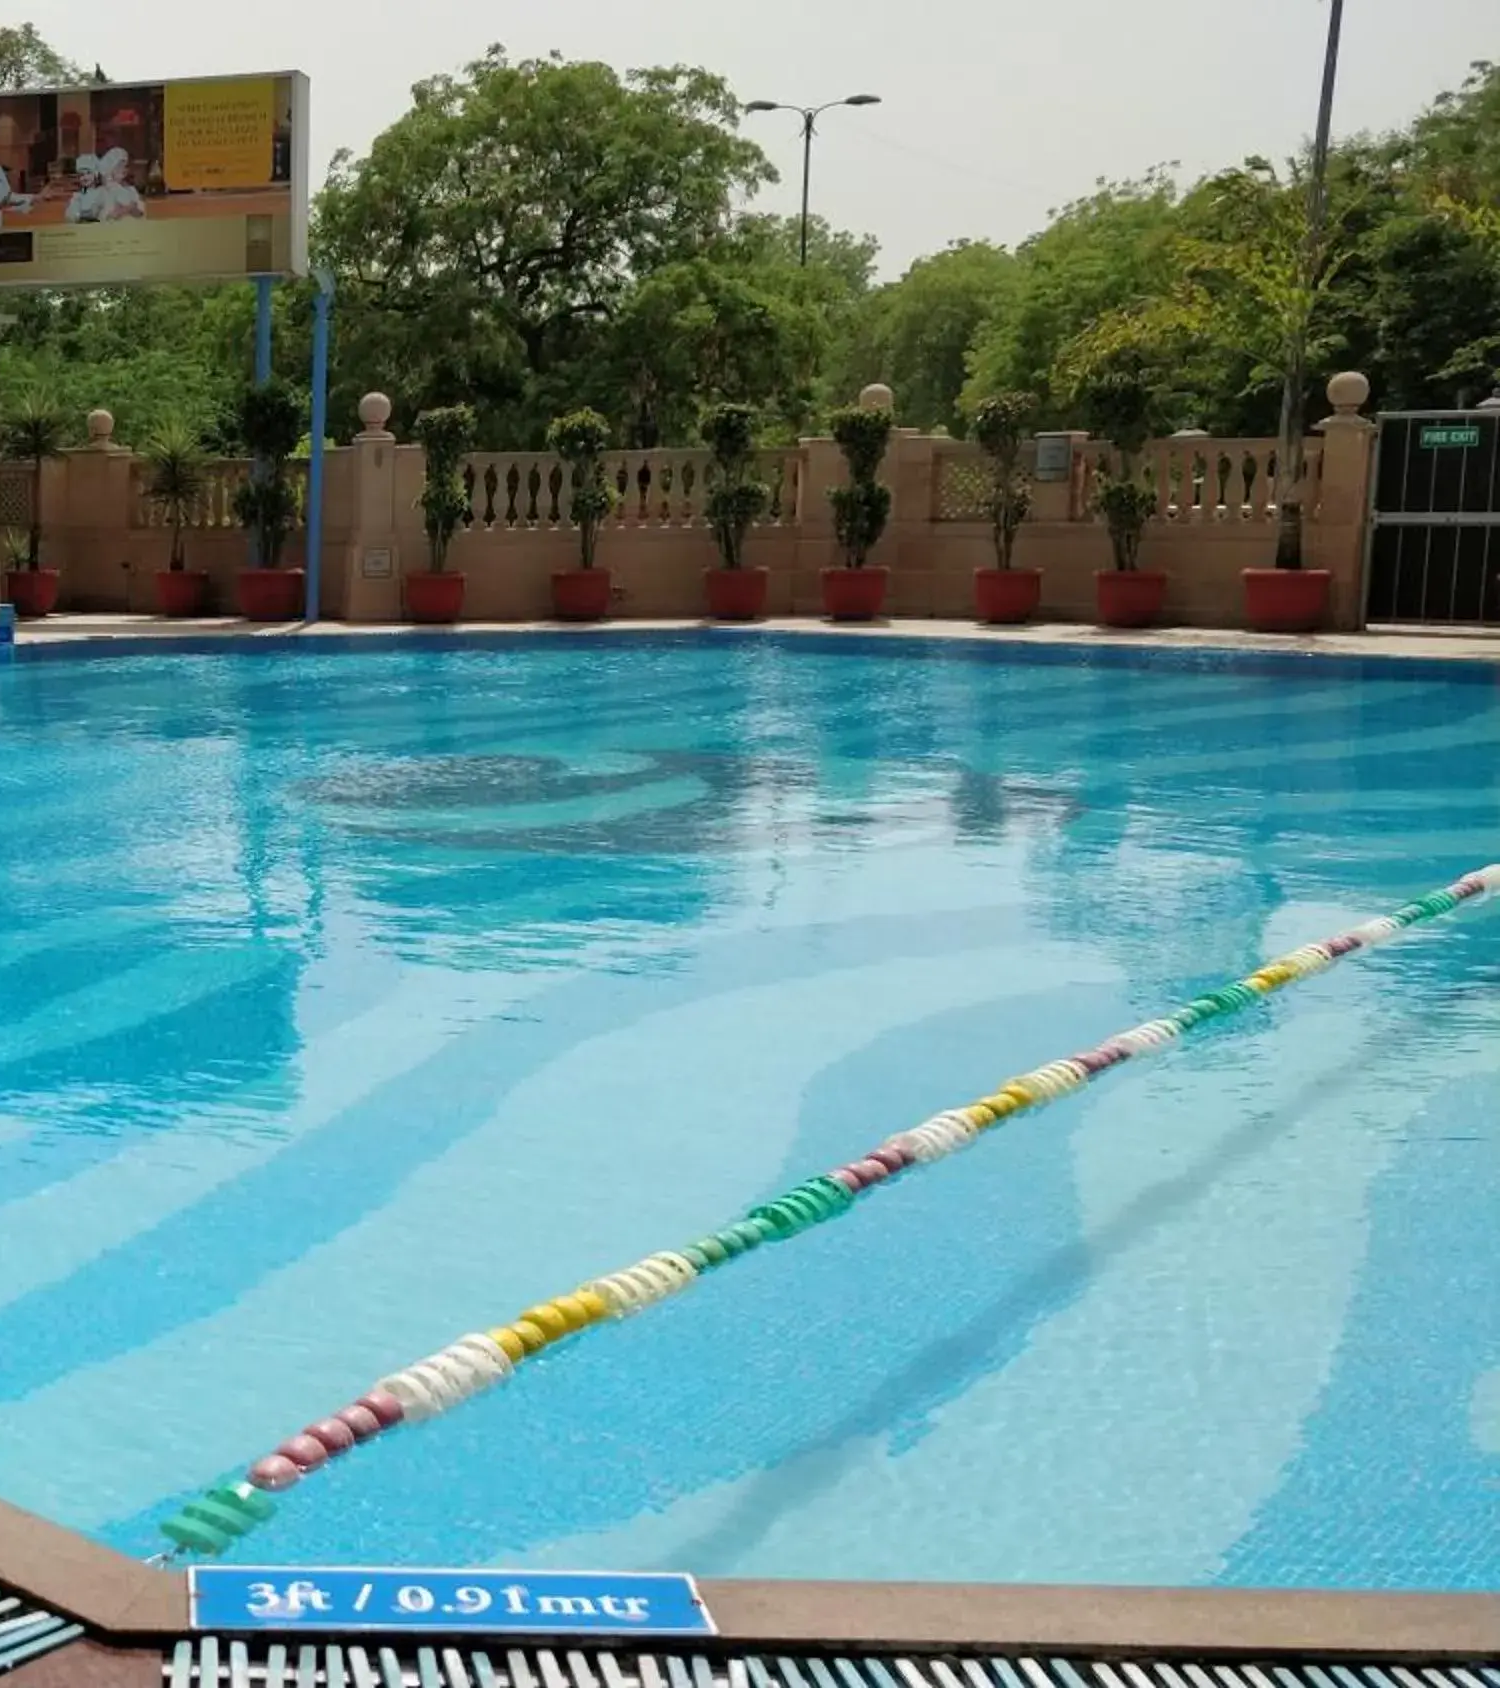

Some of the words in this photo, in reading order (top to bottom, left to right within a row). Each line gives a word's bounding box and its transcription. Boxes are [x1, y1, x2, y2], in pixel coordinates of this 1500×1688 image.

[1424, 431, 1447, 443] FIRE
[1451, 431, 1476, 442] EXIT
[246, 1581, 333, 1617] 3ft
[394, 1584, 650, 1621] 0.91mtr
